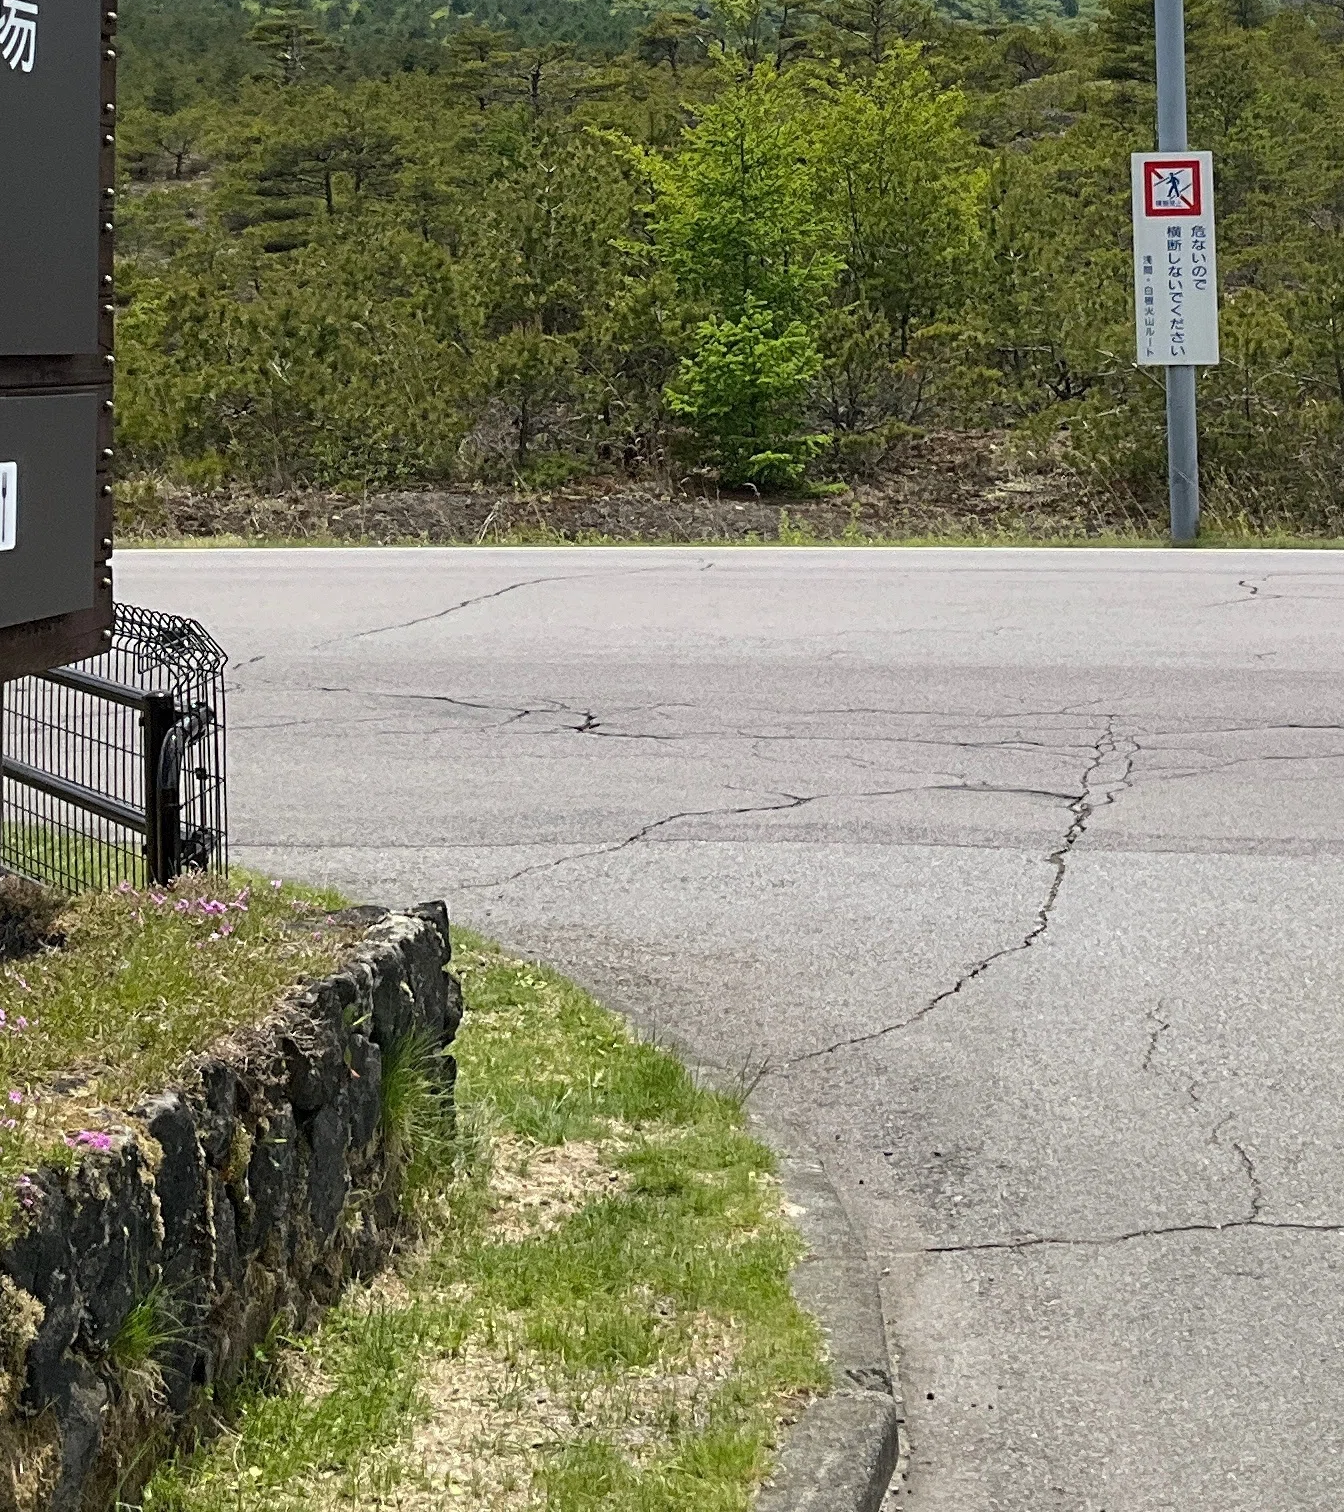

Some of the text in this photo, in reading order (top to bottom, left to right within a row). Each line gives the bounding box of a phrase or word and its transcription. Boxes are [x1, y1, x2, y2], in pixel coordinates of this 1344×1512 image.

[1167, 226, 1185, 356] 横断しないでください
[1191, 225, 1207, 291] 危ないので
